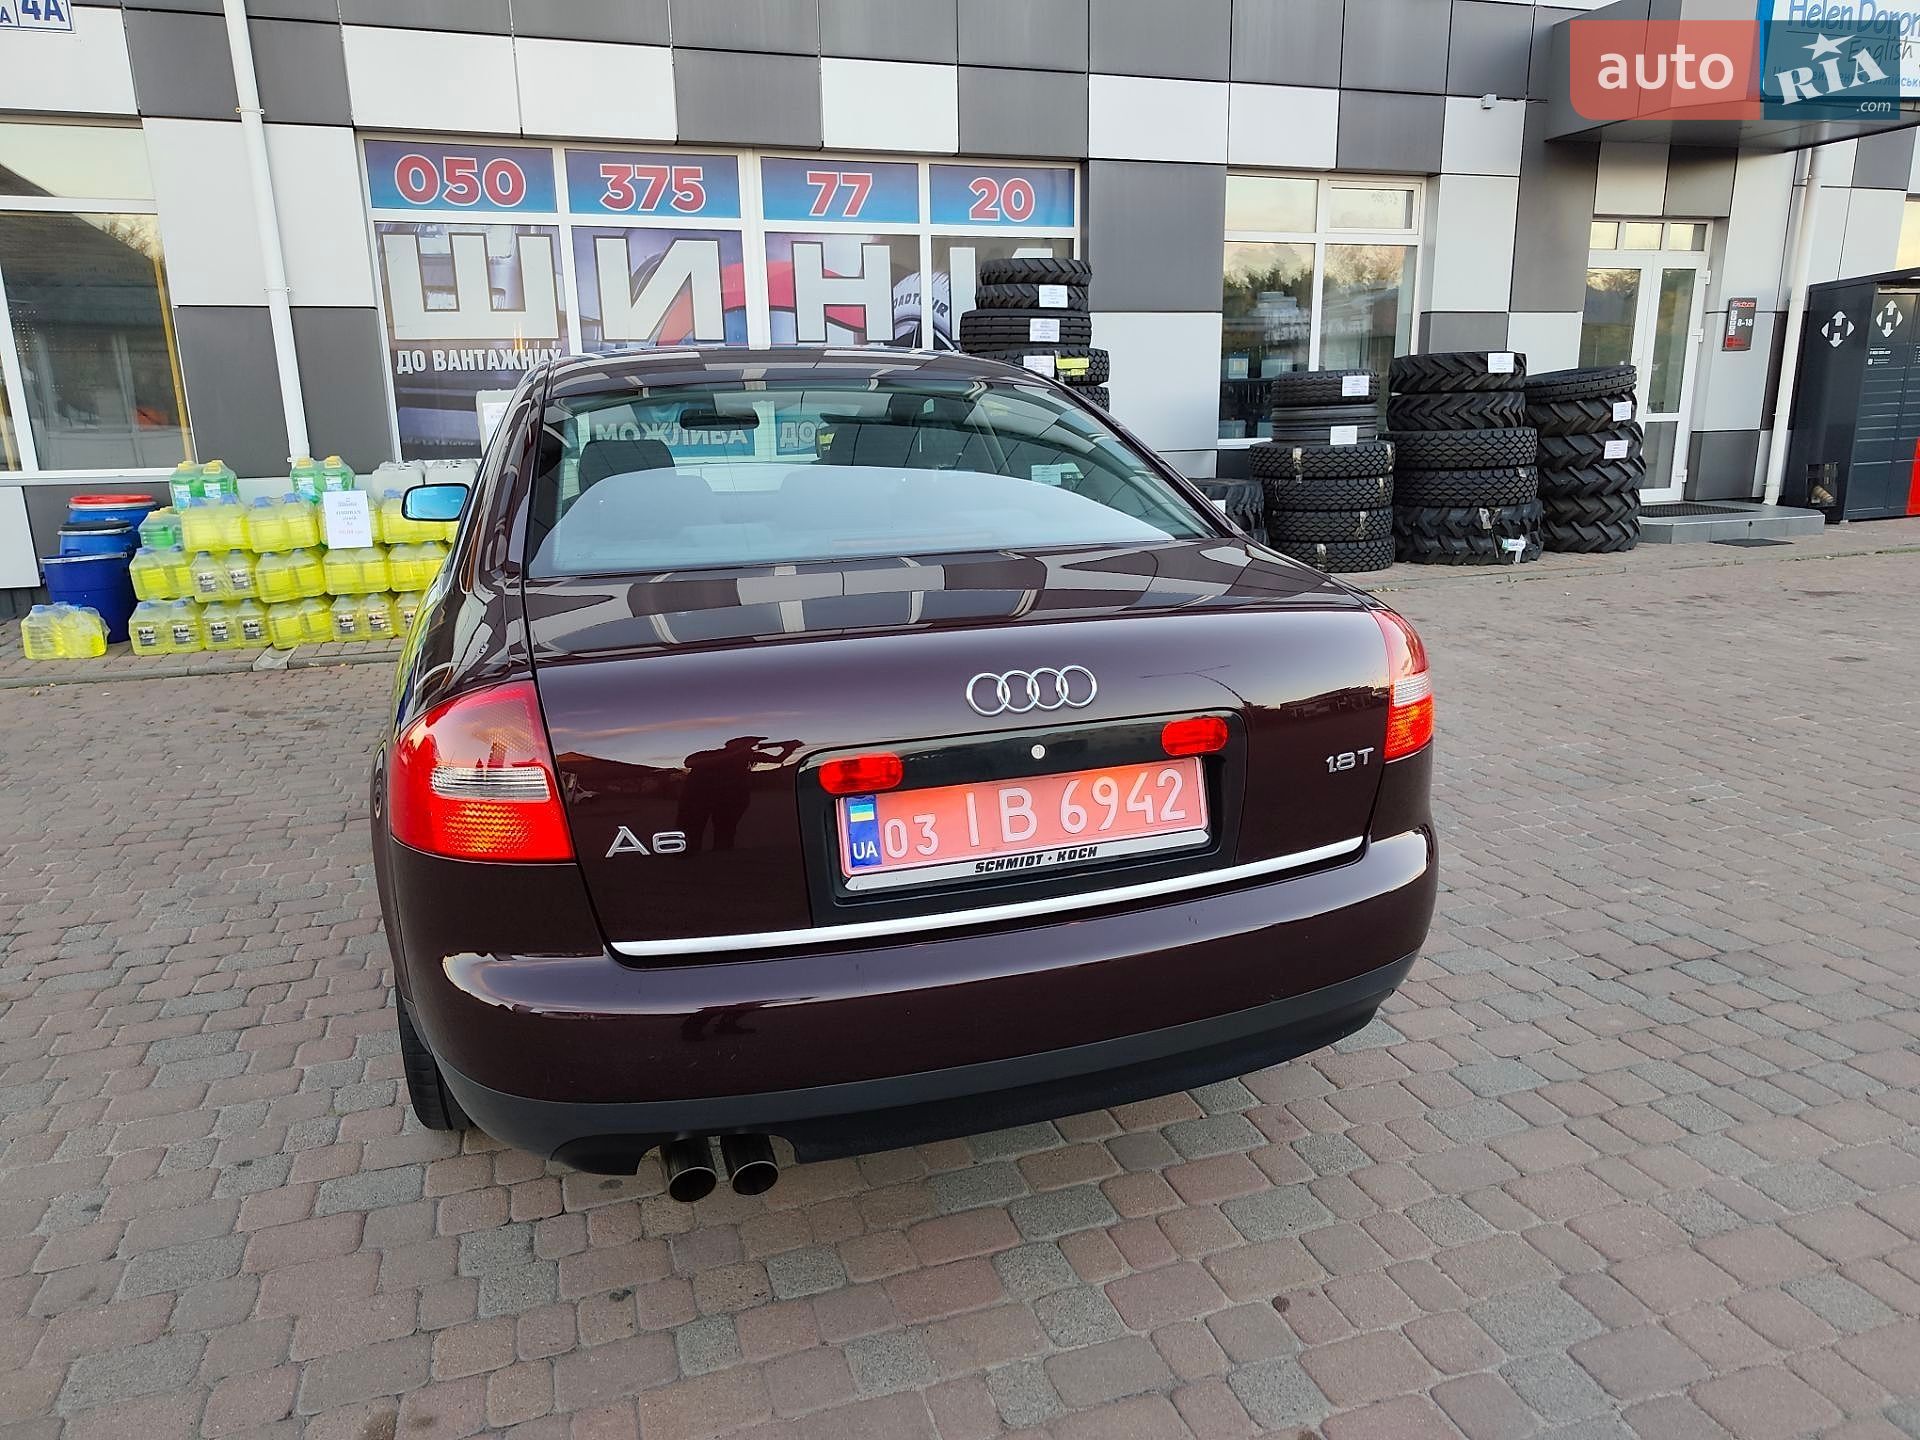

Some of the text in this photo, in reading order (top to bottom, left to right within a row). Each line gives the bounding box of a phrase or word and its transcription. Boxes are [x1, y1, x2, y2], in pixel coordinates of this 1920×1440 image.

[1788, 0, 1853, 29] Helen
[394, 154, 1035, 222] 050 375 77 20
[397, 348, 562, 374] ДО ВАНТАЖНИХ
[884, 813, 940, 858] 03
[1060, 768, 1186, 835] 6942
[605, 826, 687, 858] A6
[853, 841, 878, 860] UA
[974, 845, 1098, 874] SCHMIDT KOCH
